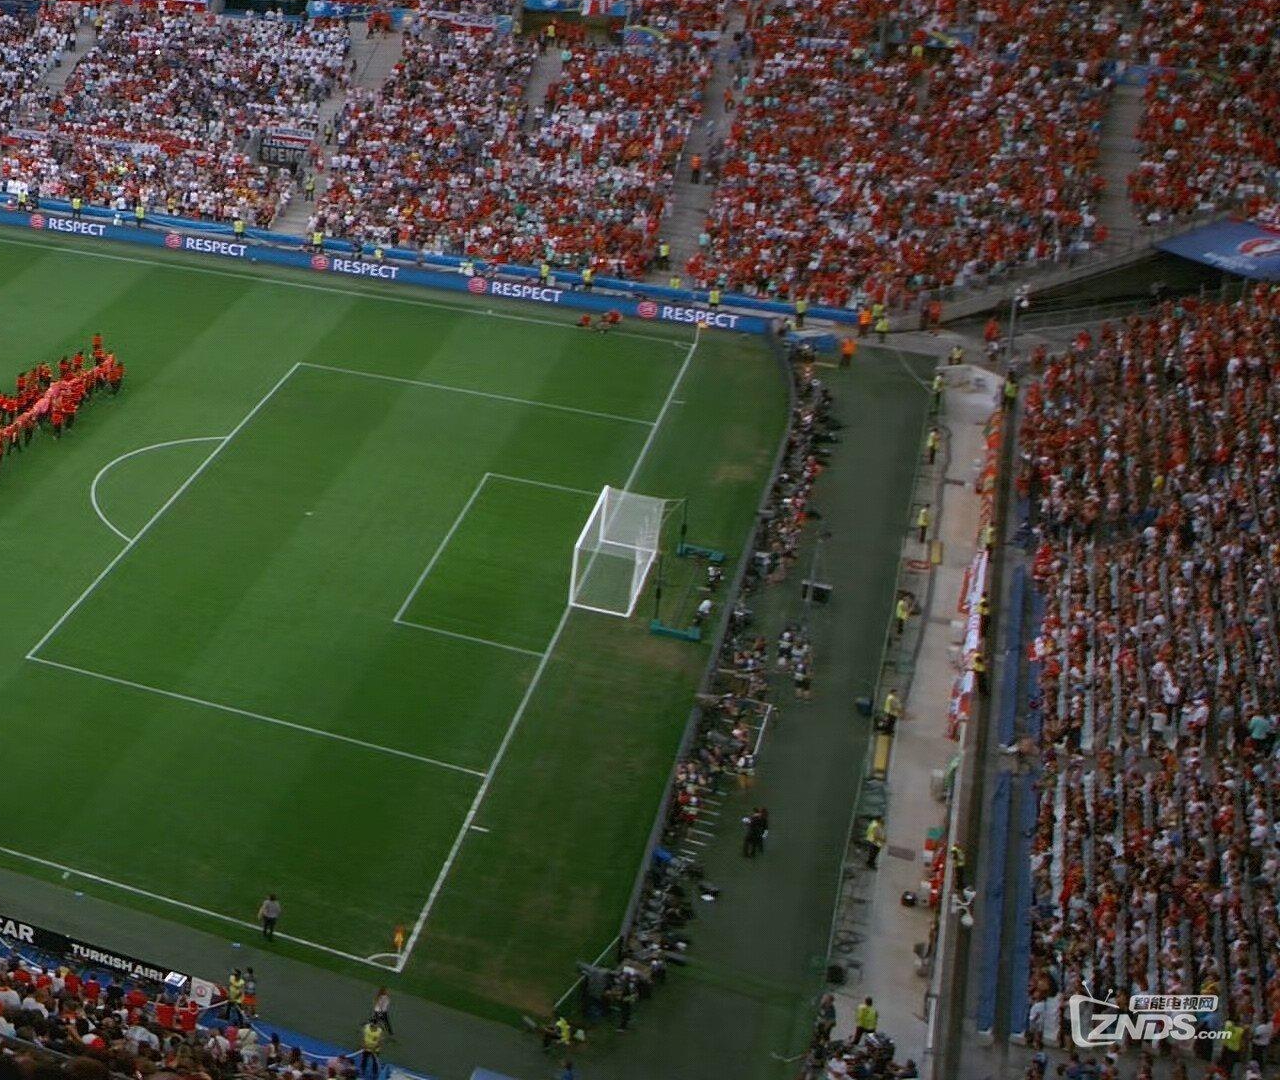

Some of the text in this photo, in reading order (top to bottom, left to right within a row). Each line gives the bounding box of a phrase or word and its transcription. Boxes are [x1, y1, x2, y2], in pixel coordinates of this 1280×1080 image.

[48, 217, 105, 237] RESPECT
[185, 236, 247, 258] RESPECT
[333, 258, 400, 280] RESPECT
[492, 280, 563, 304] RESPECT
[662, 305, 739, 329] RESPECT
[71, 943, 133, 972] TURKISH
